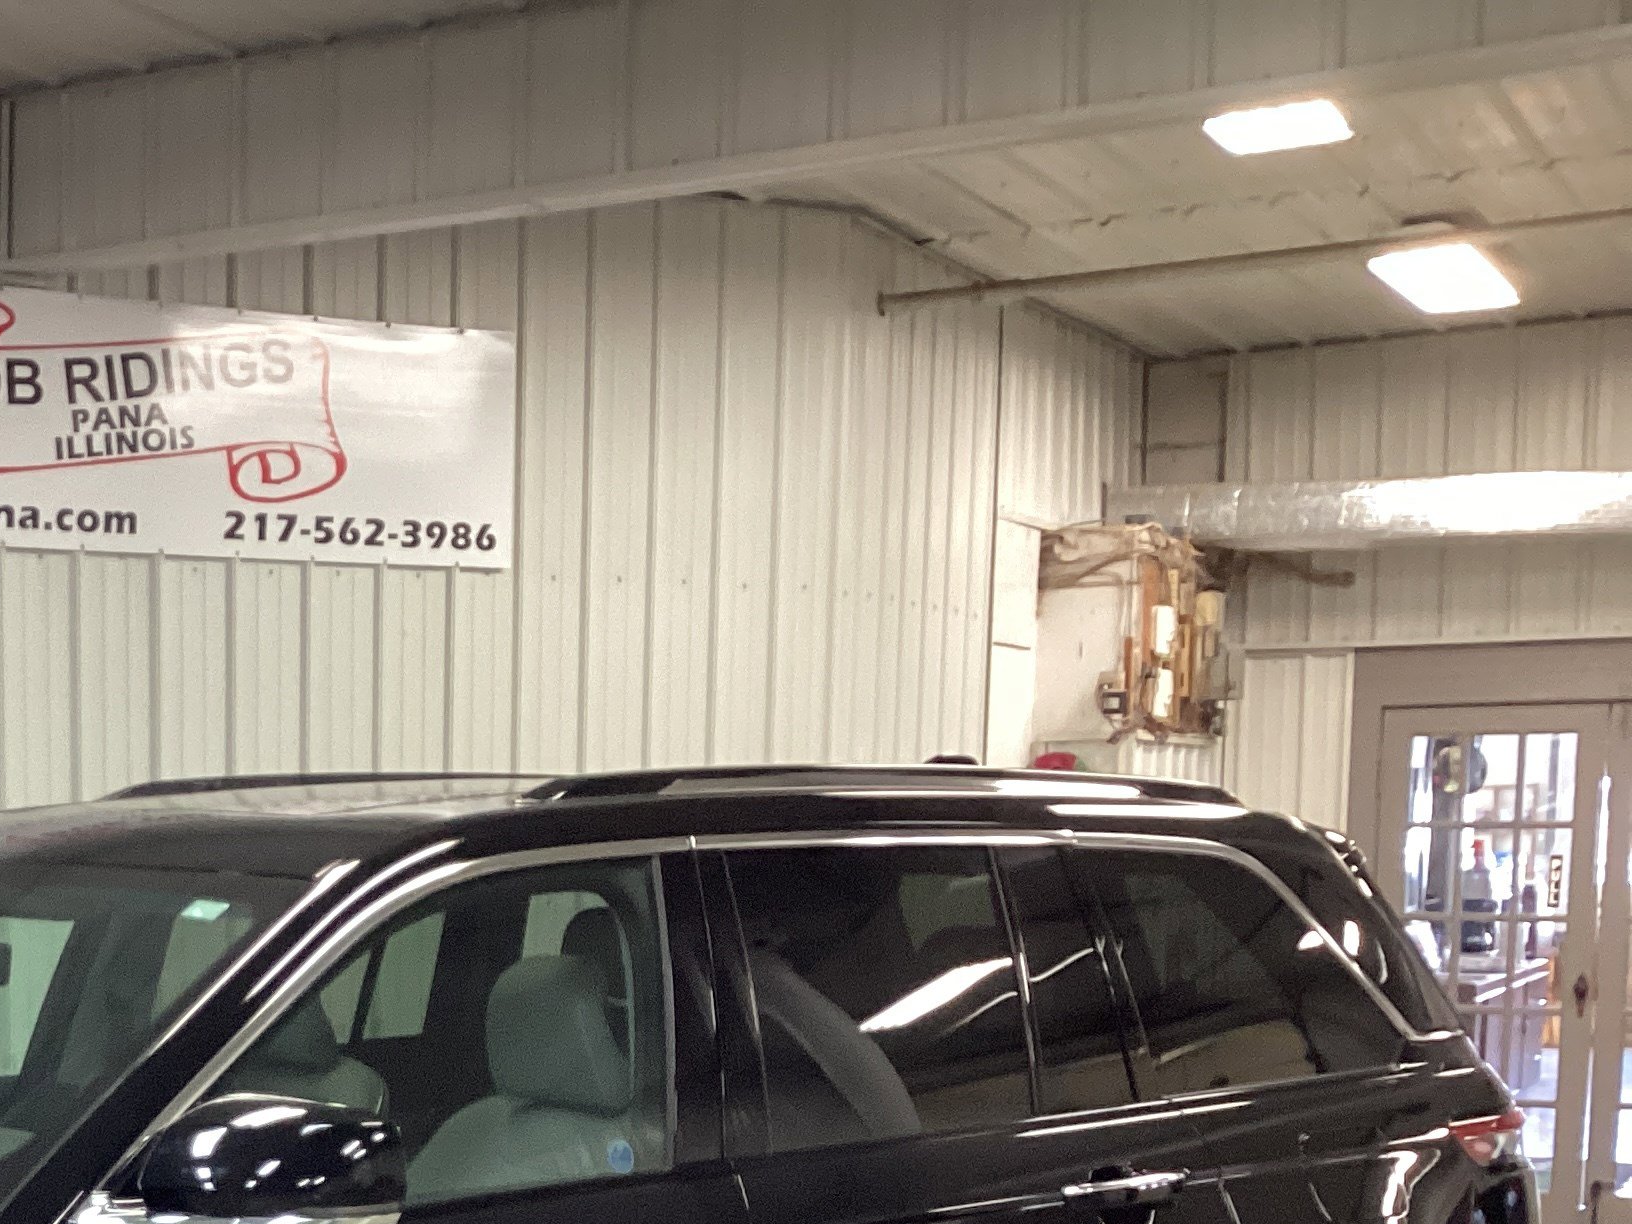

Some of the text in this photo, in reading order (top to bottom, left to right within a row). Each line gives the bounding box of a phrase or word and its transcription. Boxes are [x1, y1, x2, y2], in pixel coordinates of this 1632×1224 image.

[64, 338, 295, 405] RIDINGS
[72, 402, 169, 433] PANA
[55, 425, 196, 460] ILLINOIS
[223, 510, 498, 551] 217-562-3986
